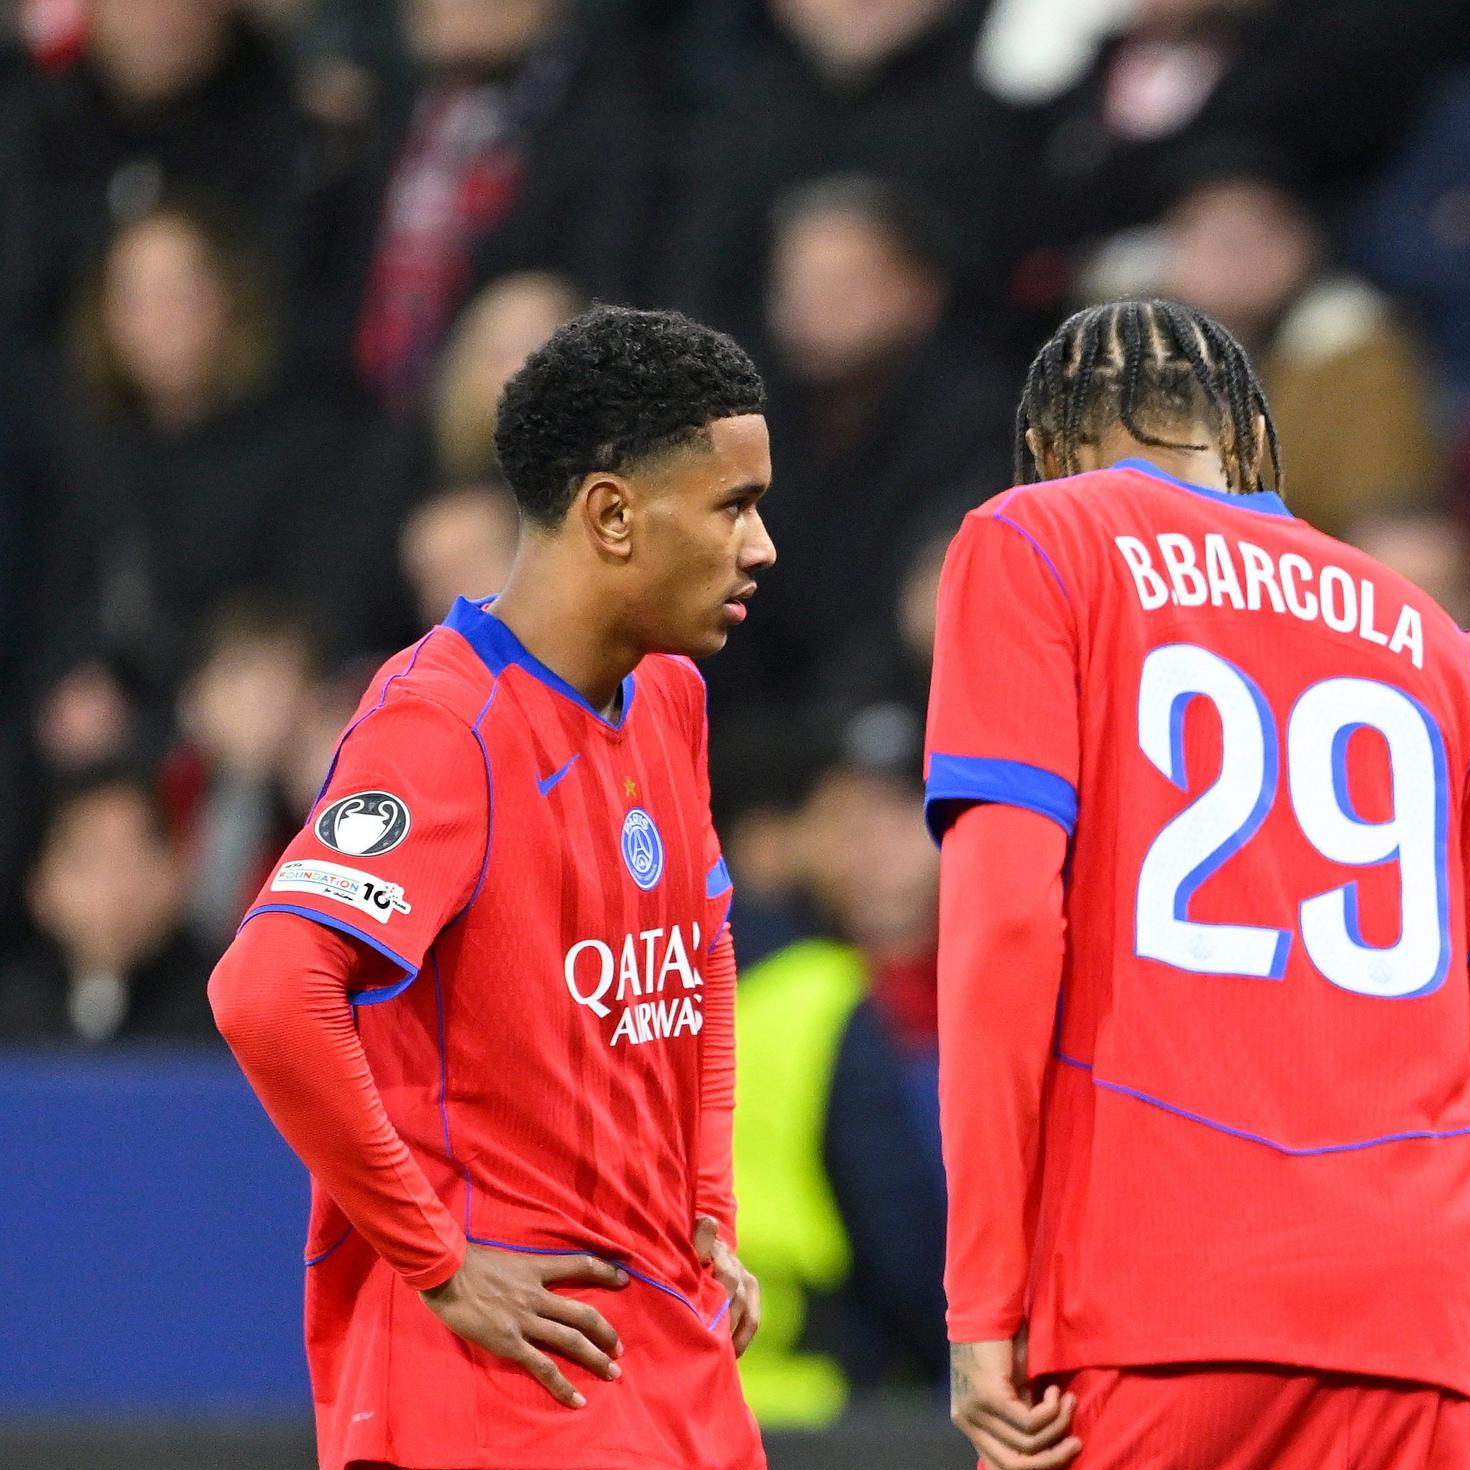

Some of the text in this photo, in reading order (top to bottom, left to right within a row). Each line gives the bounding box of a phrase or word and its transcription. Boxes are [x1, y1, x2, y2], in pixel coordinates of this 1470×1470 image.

[1115, 533, 1425, 669] B.BARCOLA
[1134, 642, 1453, 998] 29
[610, 994, 704, 1047] AIRWA
